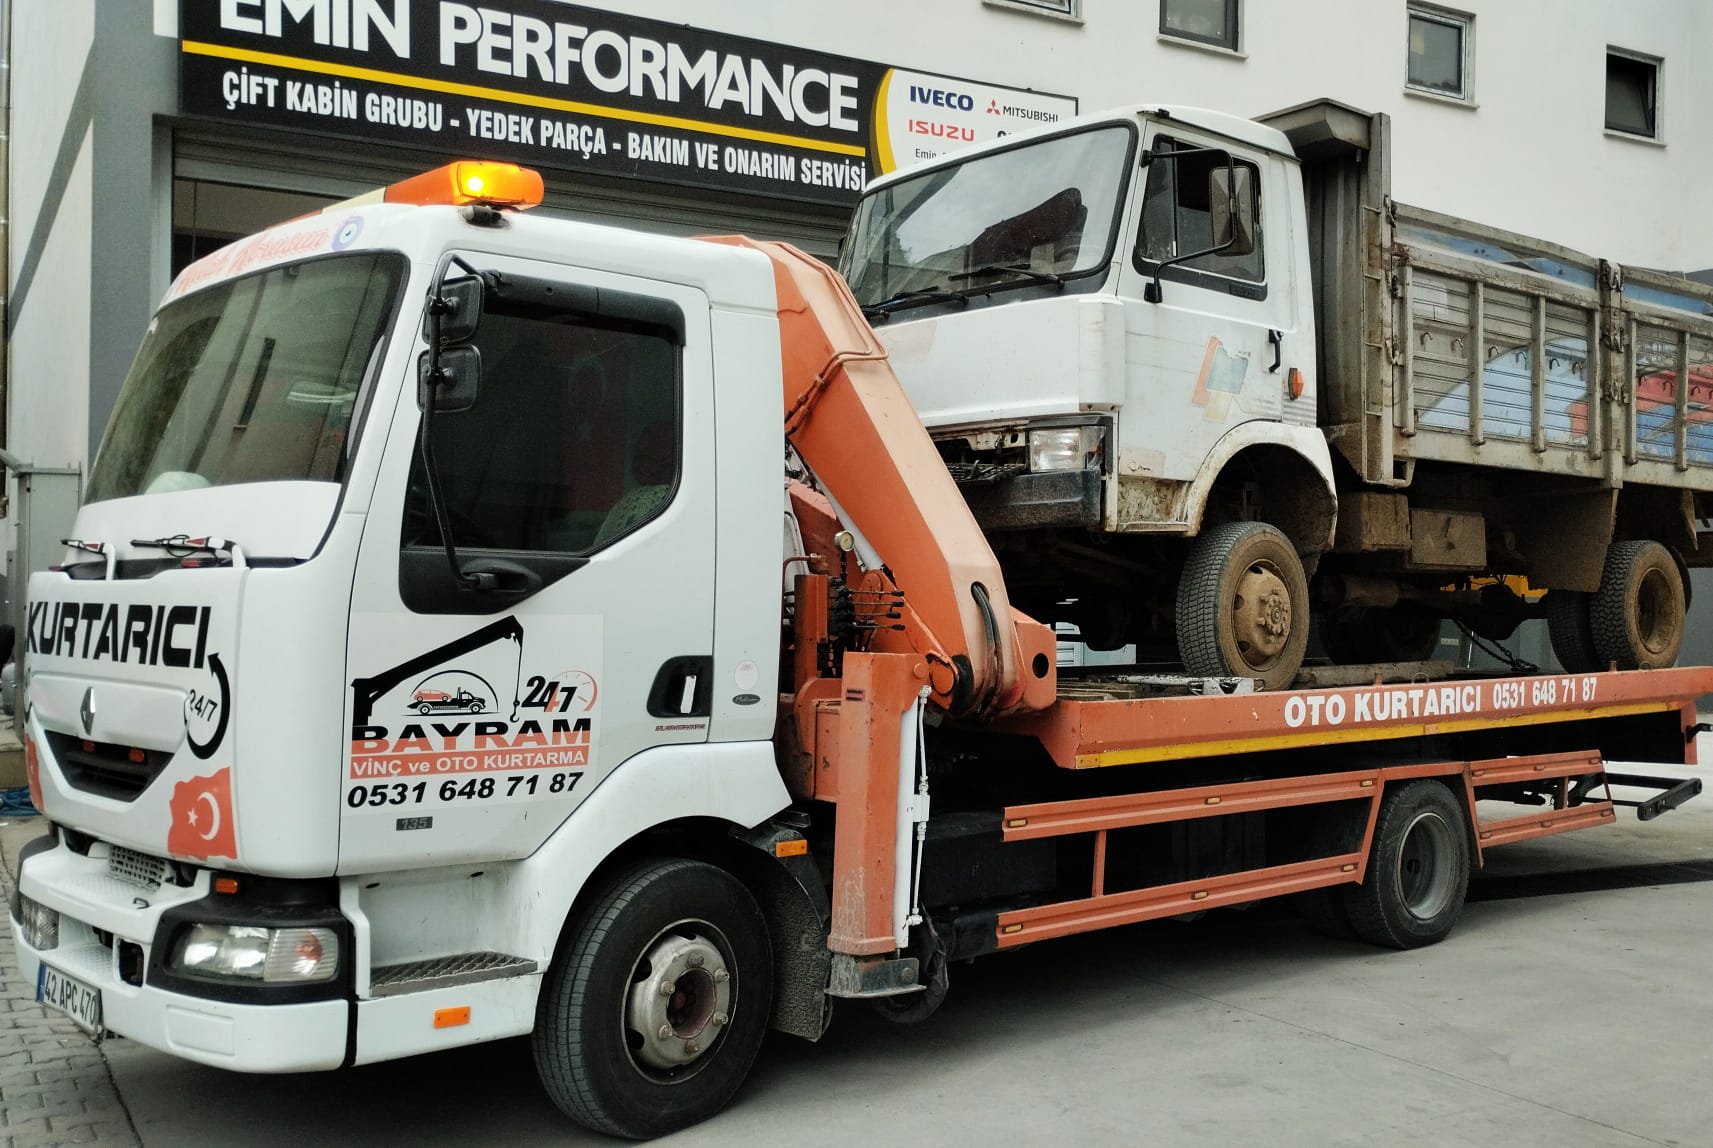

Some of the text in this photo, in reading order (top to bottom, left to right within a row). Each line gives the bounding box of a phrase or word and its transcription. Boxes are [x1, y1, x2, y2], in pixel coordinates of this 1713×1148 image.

[439, 1, 859, 132] PERFORMANCE
[910, 85, 974, 111] IVECO
[1003, 105, 1059, 123] MITSUBISHI
[222, 67, 279, 109] ÇİFT
[286, 81, 358, 120] KABİN
[364, 93, 443, 132] GRUBU
[466, 108, 534, 146] YEDEK
[540, 120, 607, 160] PARÇA
[627, 132, 690, 166] BAKIM
[695, 142, 719, 170] VE
[724, 147, 796, 182] ONARIM
[800, 157, 867, 191] SERVİSİ
[908, 119, 975, 142] ISUZU
[26, 601, 212, 669] KURTARICI
[189, 688, 218, 722] 24/7
[1284, 677, 1597, 728] OTO KURTARICI 0531 648 71 87
[351, 717, 592, 755] BAYRAM
[353, 750, 585, 777] VİNÇ ve OTO KURTARMA
[347, 771, 584, 808] 0531 648 71 87
[45, 971, 97, 1026] 42 APC 470
